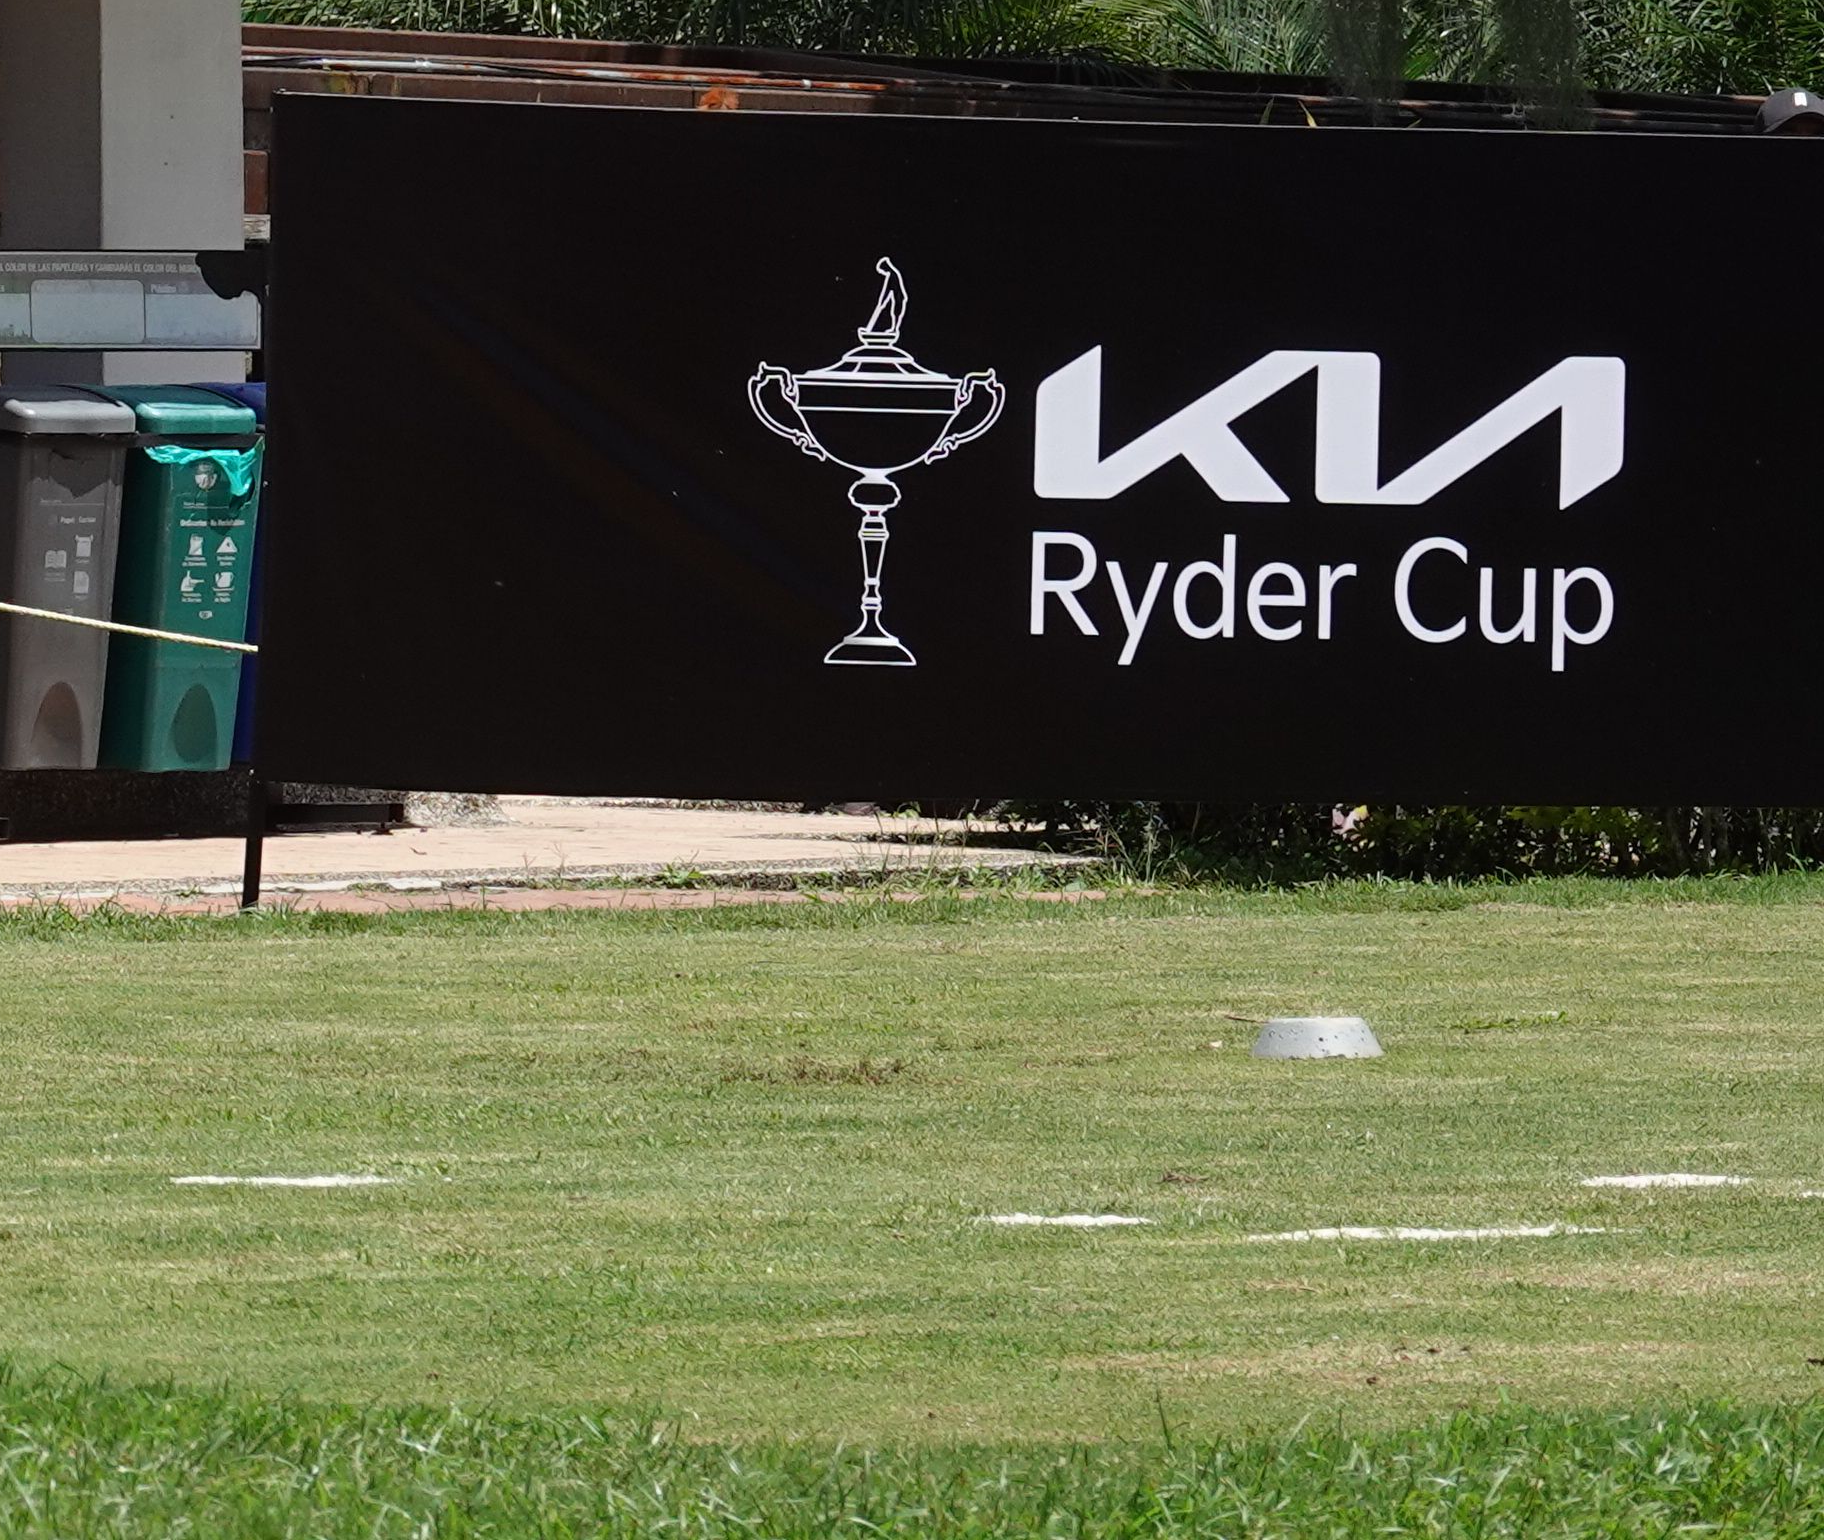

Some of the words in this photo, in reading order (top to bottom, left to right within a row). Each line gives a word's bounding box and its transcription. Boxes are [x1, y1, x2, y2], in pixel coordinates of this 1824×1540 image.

[1034, 345, 1625, 510] KIA
[1030, 532, 1357, 665] Ryder
[1394, 537, 1614, 672] Cup
